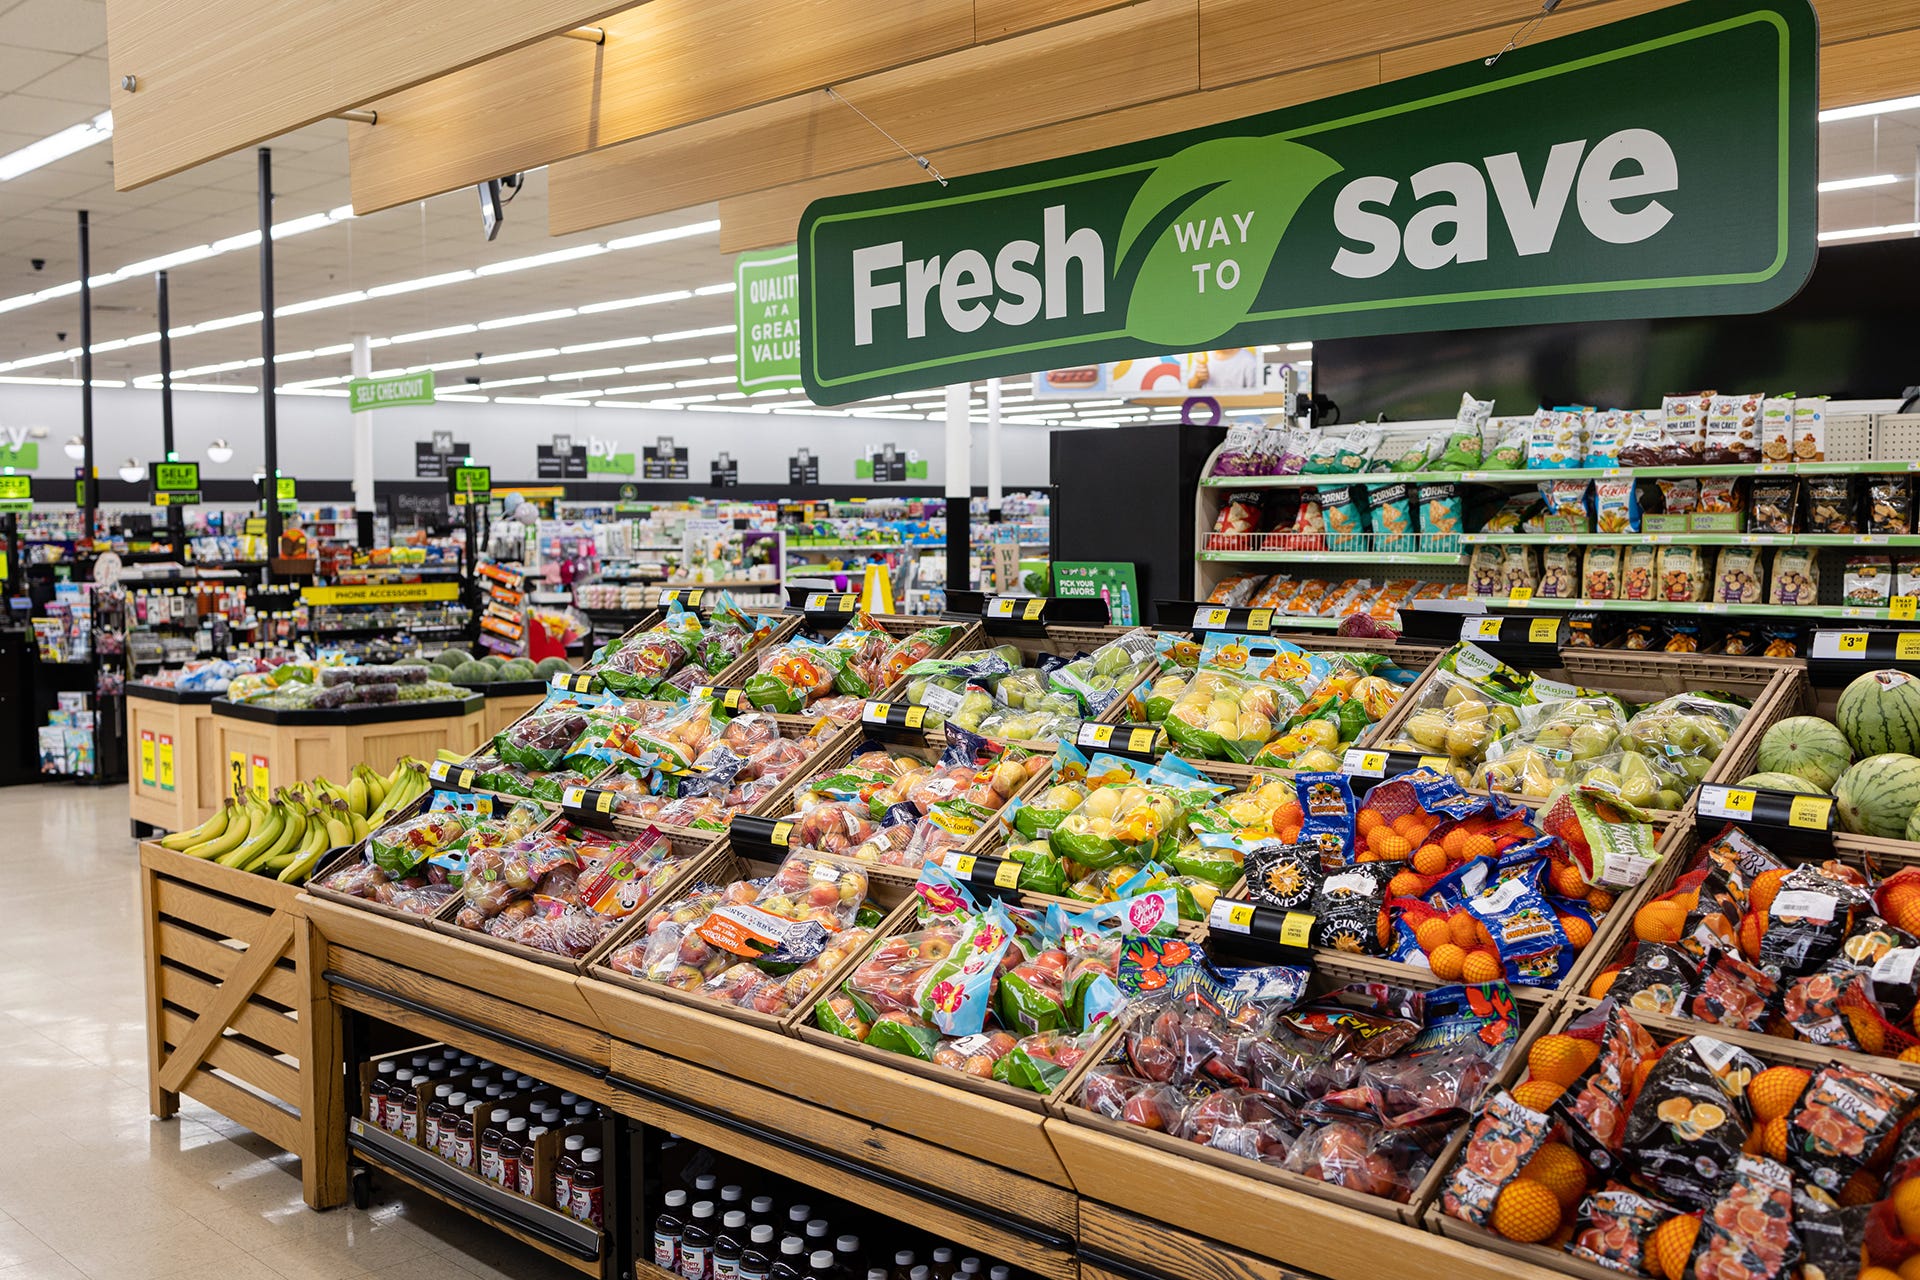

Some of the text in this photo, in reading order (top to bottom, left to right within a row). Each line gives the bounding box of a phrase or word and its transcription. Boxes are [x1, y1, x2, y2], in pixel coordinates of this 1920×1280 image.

[1330, 128, 1679, 281] save
[1174, 211, 1255, 254] WAY
[852, 204, 1106, 346] Fresh
[1192, 259, 1241, 294] TO
[764, 303, 789, 318] AT A
[357, 379, 423, 403] SELF CHECKOUT
[162, 469, 193, 479] SELF
[336, 588, 427, 599] PHONE ACCESSORIES
[1061, 587, 1095, 596] FLAVORS
[1076, 580, 1094, 588] YOUR
[1460, 650, 1494, 670] d'Anjou
[1133, 897, 1158, 921] Pink
[1138, 907, 1161, 928] Lady
[1320, 919, 1367, 946] DULCINEA
[1506, 924, 1551, 940] sweetums
[1171, 968, 1245, 1016] MOONLIGHT
